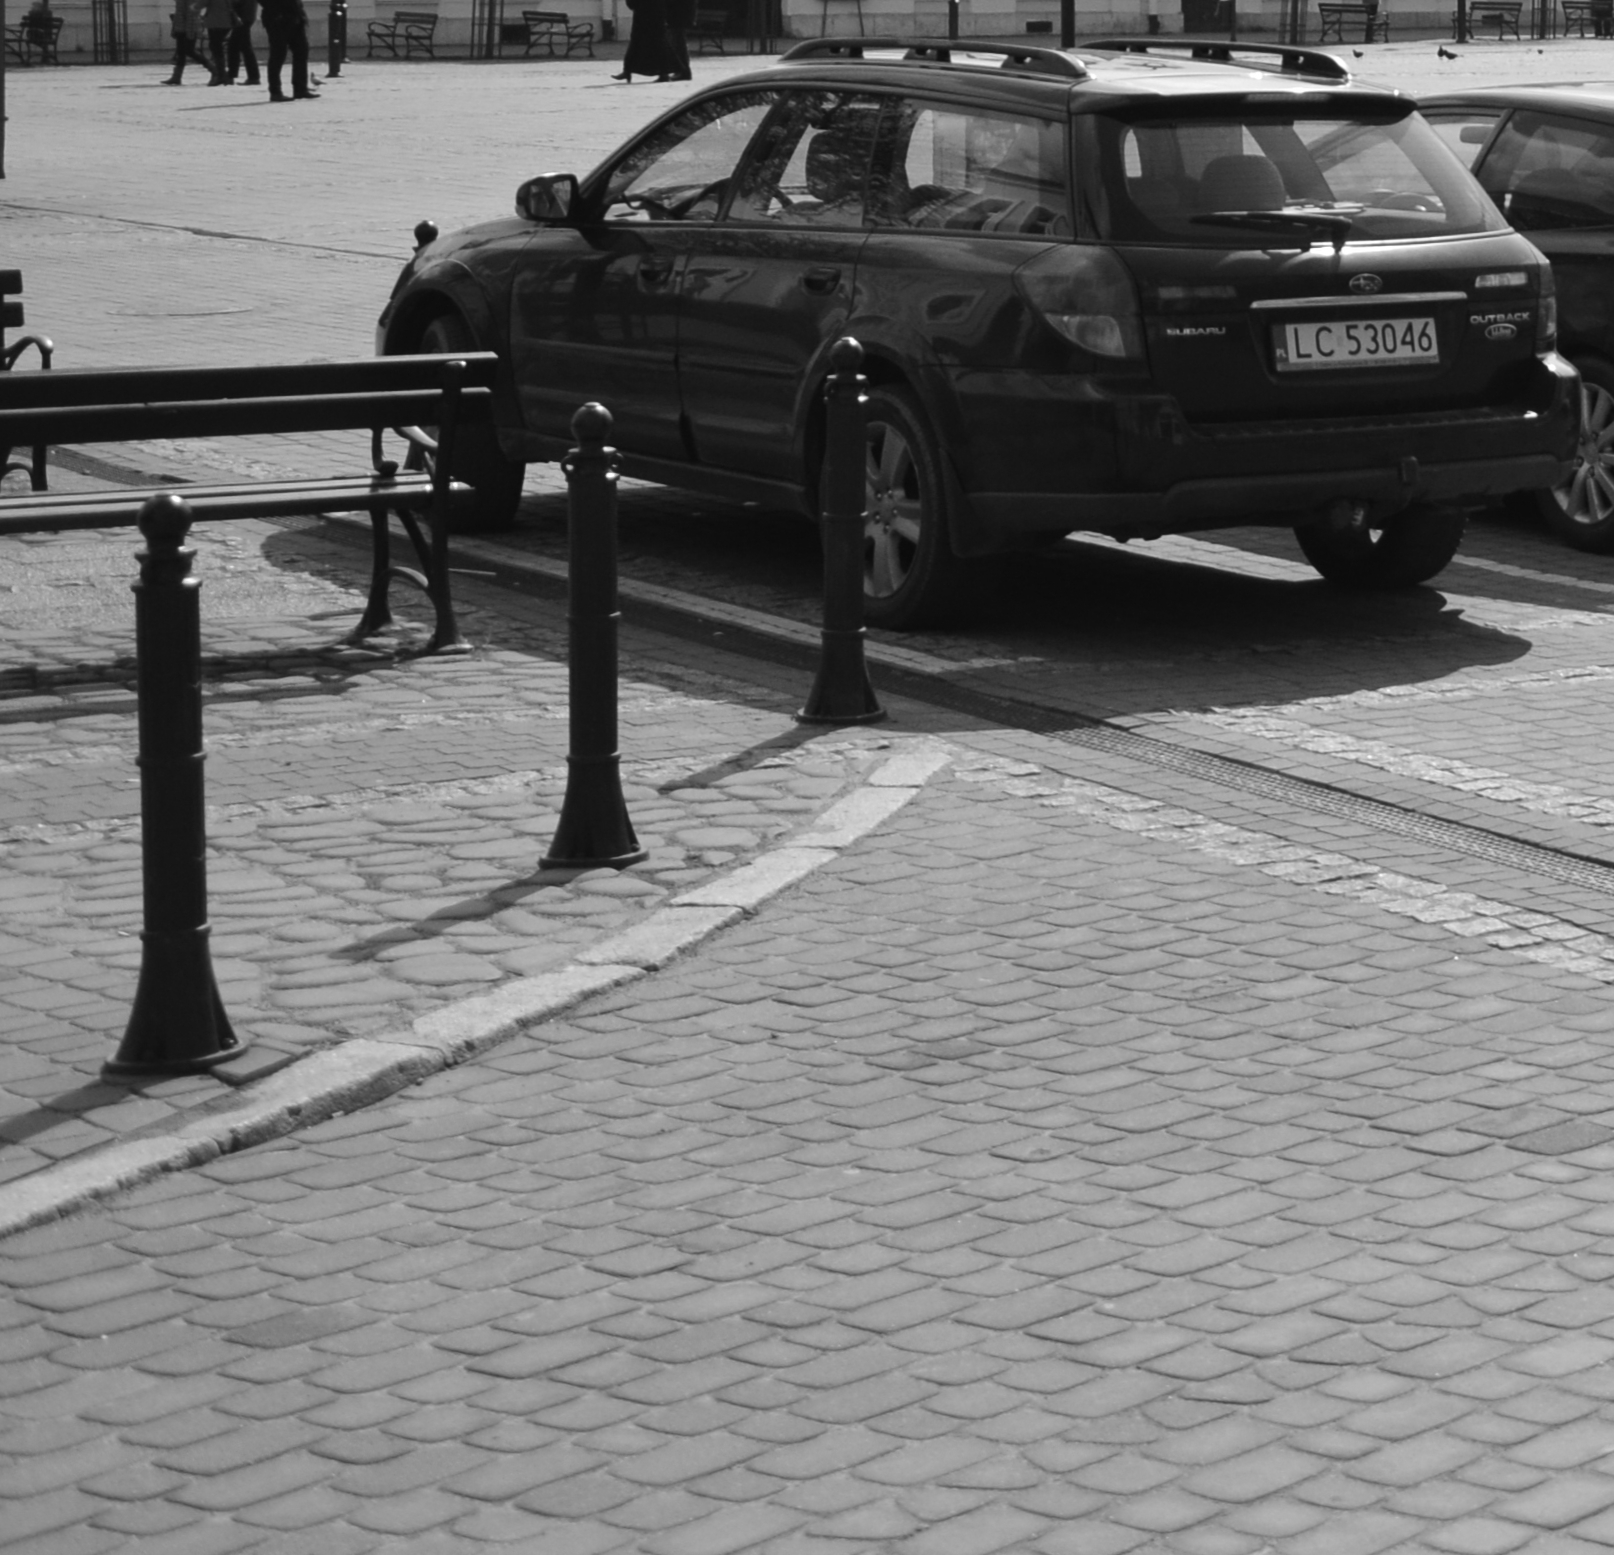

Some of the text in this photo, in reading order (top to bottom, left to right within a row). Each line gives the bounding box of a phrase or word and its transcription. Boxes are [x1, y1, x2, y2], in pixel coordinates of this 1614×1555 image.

[1470, 312, 1530, 324] OUTBACK
[1166, 327, 1226, 336] SUBARU
[1293, 321, 1434, 359] LC 53046
